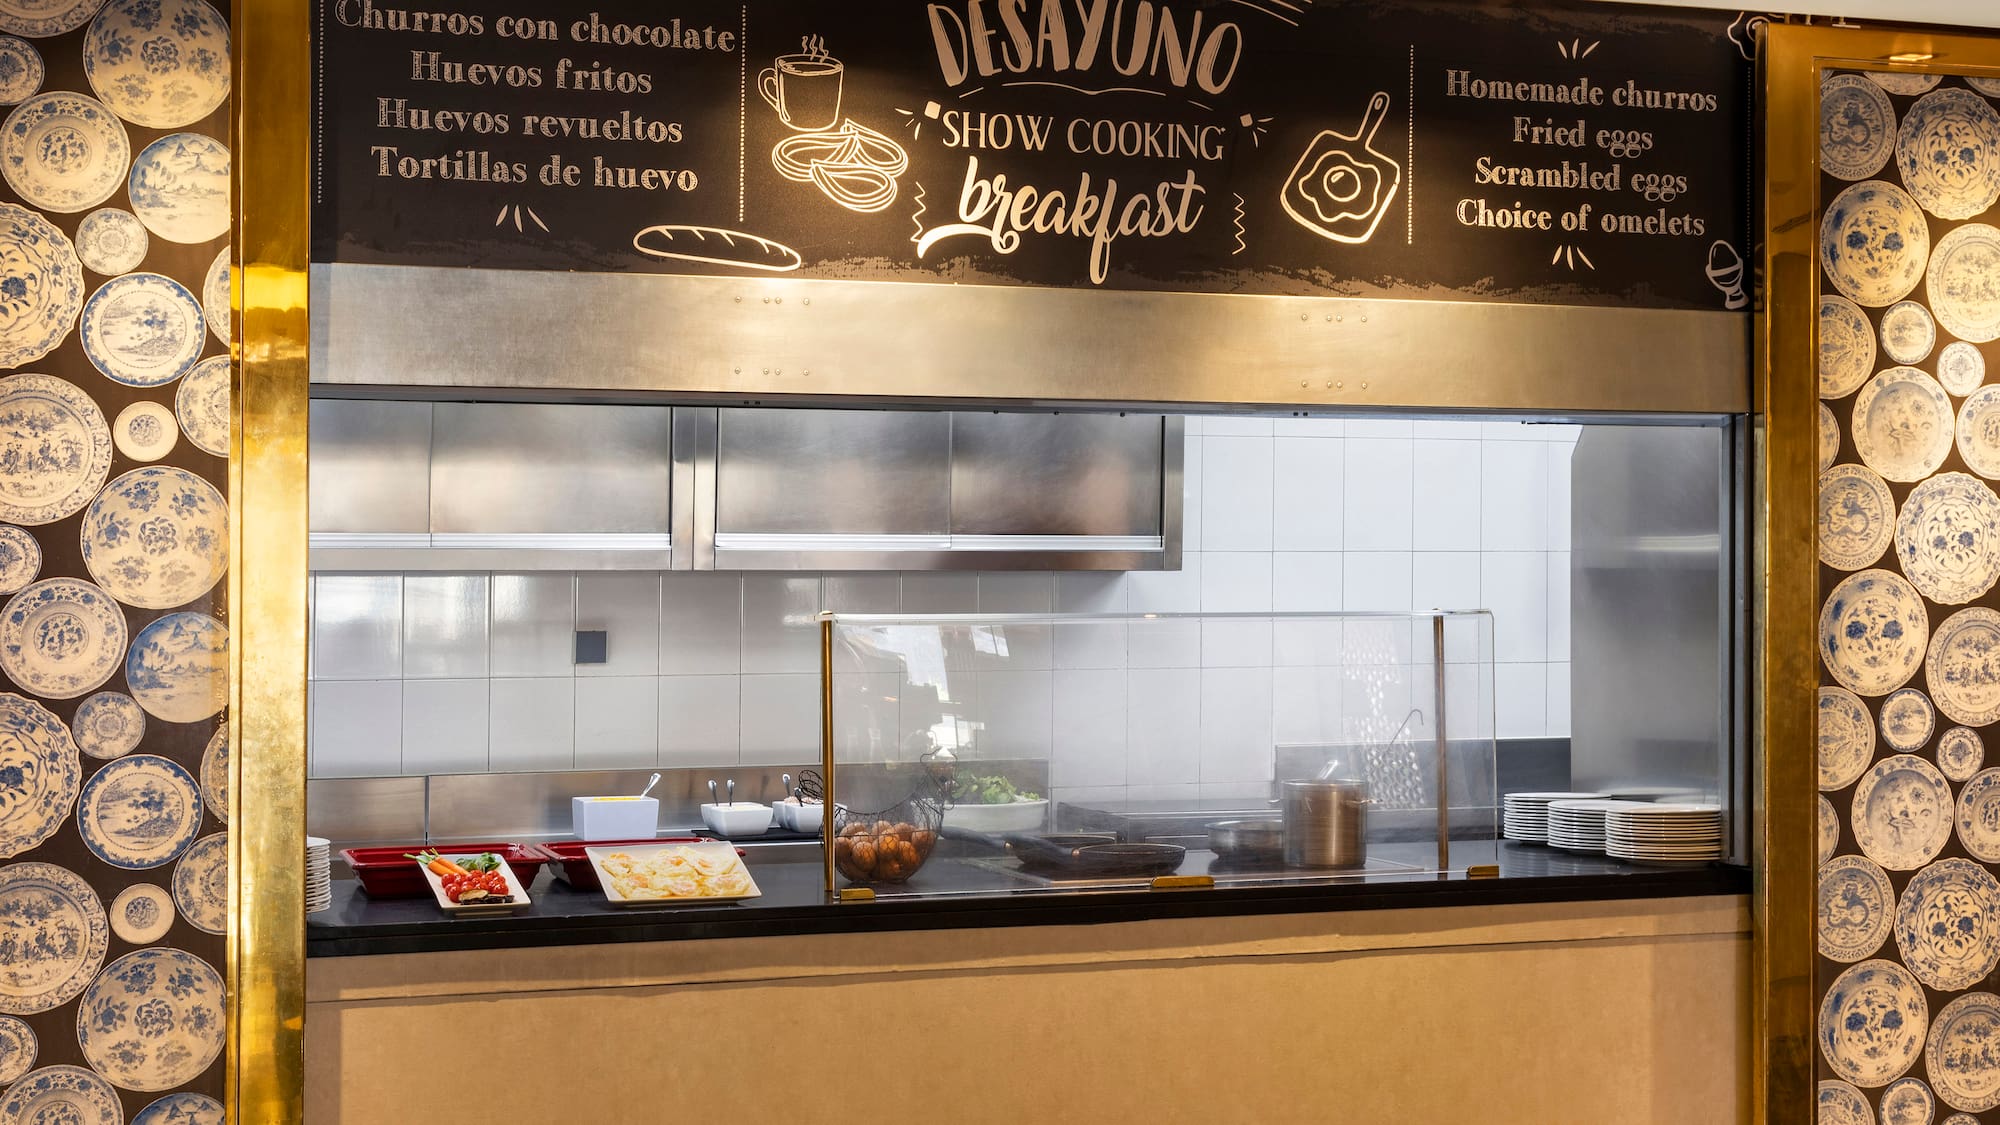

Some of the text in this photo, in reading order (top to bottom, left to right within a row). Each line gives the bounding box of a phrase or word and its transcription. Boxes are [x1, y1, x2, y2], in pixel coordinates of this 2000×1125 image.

[335, 0, 736, 53] Churros con chocolate
[926, 0, 1243, 95] DESAYUNO
[410, 50, 653, 94] Huevos fritos
[1445, 68, 1718, 112] Homemade churros
[376, 97, 683, 144] Huevos revueltos
[941, 109, 1227, 161] SHOW COOKING
[1512, 116, 1654, 159] Fried eggs
[370, 145, 699, 192] Tortillas de huevo
[1474, 156, 1688, 203] Scrambled eggs
[916, 155, 1207, 286] breakfast
[1456, 198, 1705, 237] Choice of omelets
